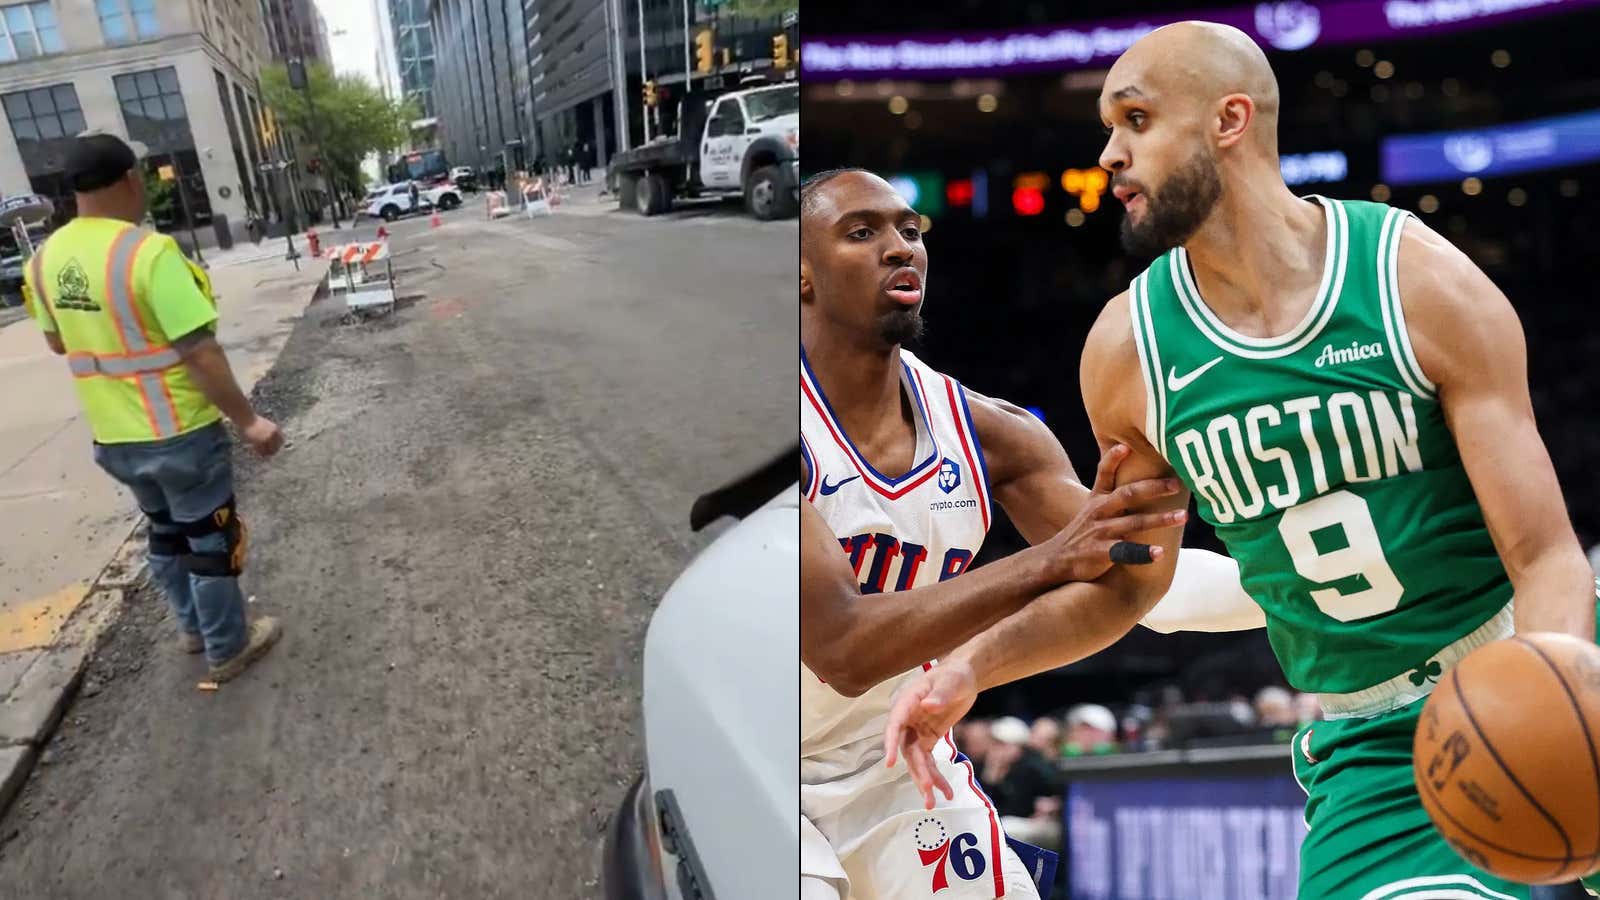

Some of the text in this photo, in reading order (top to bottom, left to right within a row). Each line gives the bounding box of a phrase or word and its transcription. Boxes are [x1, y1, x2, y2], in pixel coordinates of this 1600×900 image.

[1314, 341, 1384, 368] Amica
[1174, 390, 1424, 524] BOSTON
[930, 498, 977, 511] crypto.com
[1277, 489, 1405, 623] 9
[917, 832, 986, 894] 76
